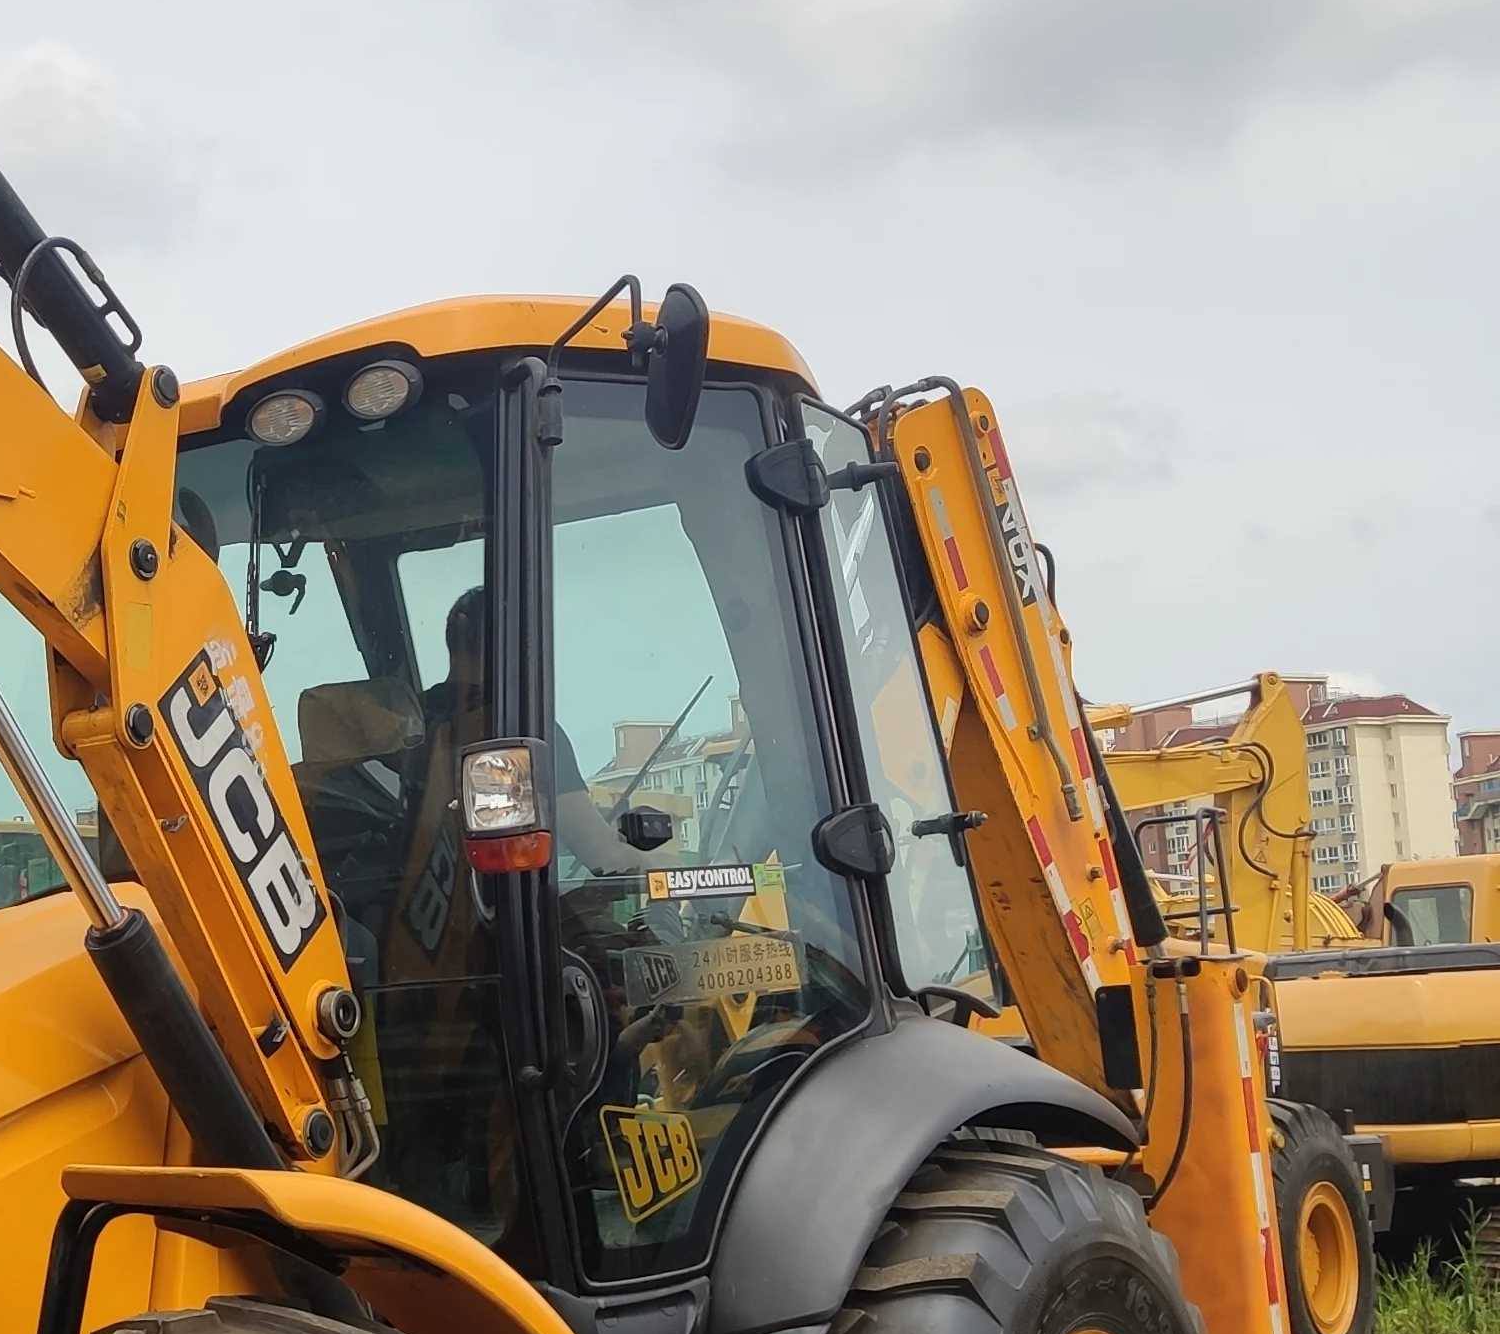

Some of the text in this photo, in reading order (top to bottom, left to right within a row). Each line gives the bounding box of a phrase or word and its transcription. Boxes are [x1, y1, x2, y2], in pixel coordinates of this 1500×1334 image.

[169, 685, 317, 956] JCB
[642, 952, 679, 996] JCB
[692, 941, 792, 969] 24小时服务热线
[697, 962, 793, 991] 4008204388
[618, 1117, 695, 1208] JCB
